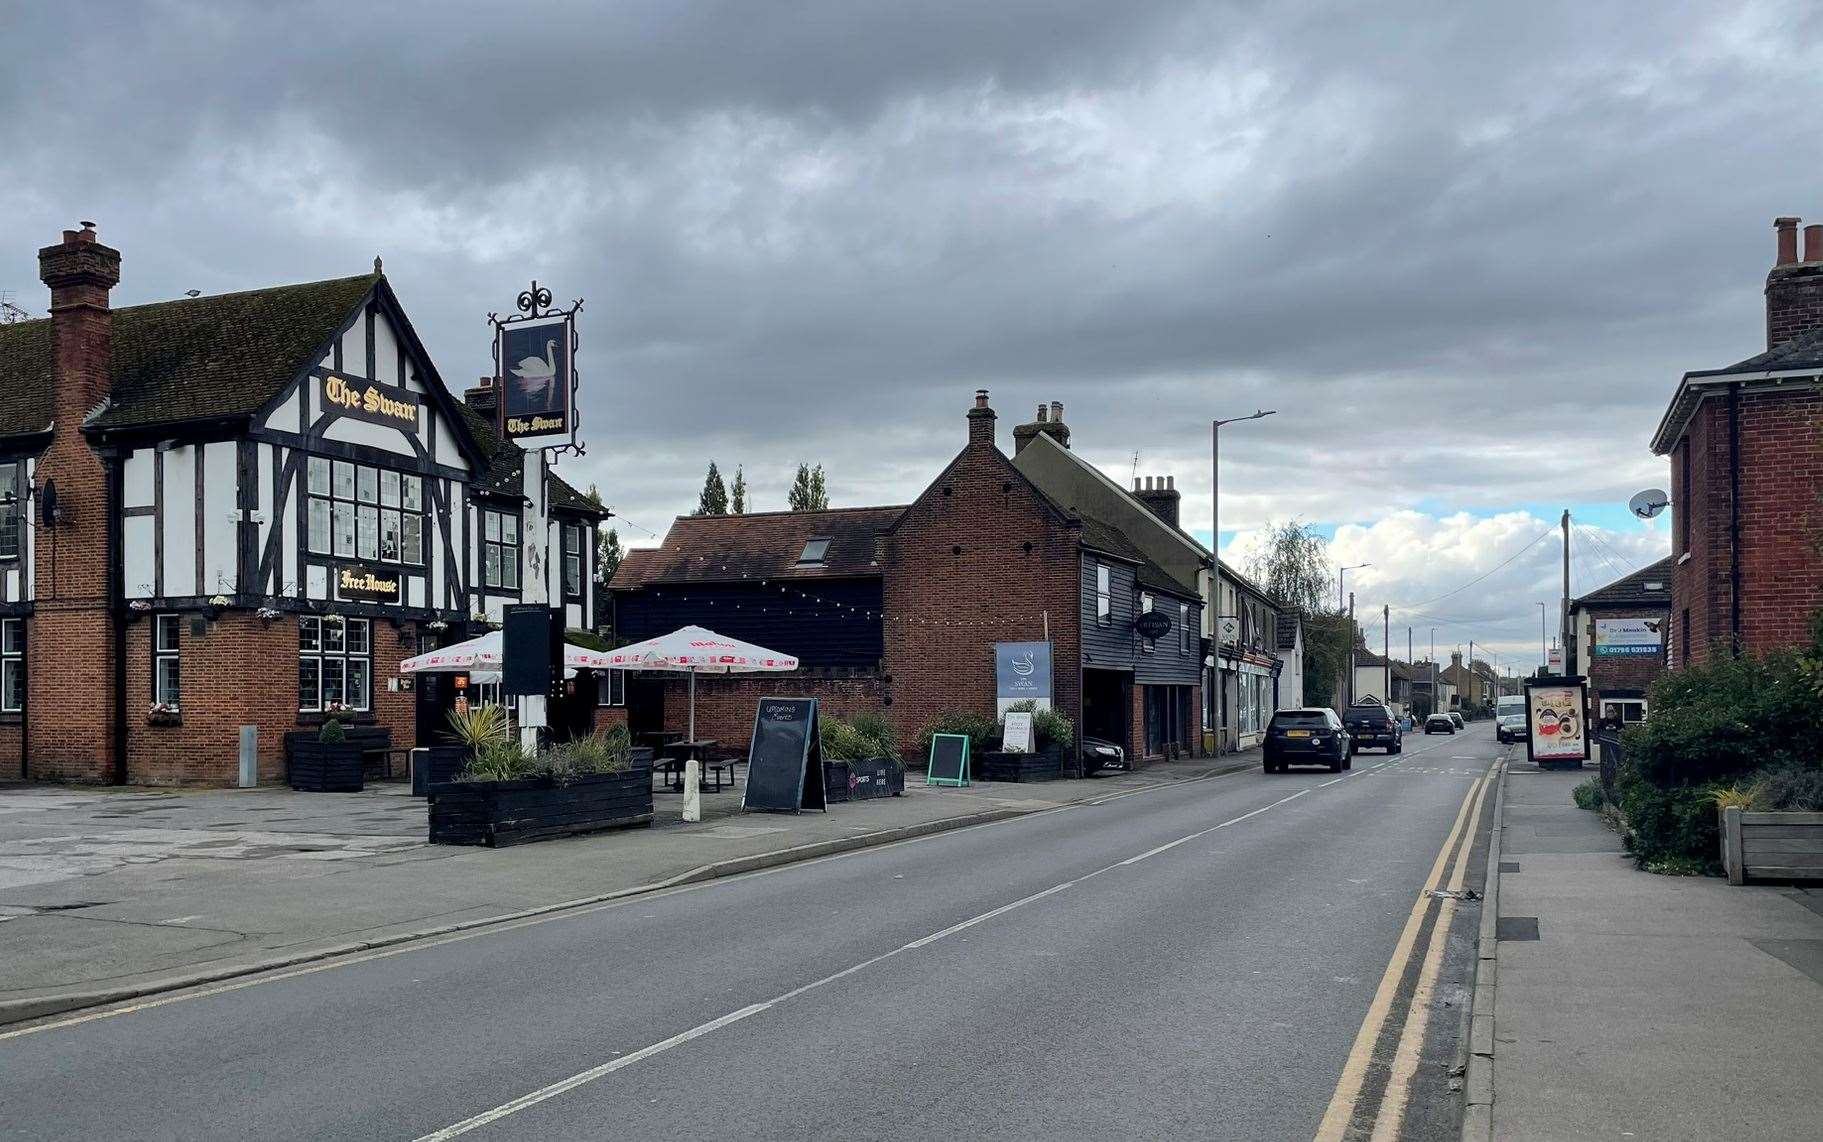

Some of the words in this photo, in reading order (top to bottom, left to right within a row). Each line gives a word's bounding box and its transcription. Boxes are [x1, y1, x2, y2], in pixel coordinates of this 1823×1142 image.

[326, 376, 360, 409] The
[363, 385, 417, 422] Swan
[508, 418, 530, 433] The
[531, 416, 563, 431] Swan
[340, 569, 365, 589] Free
[365, 573, 397, 592] House
